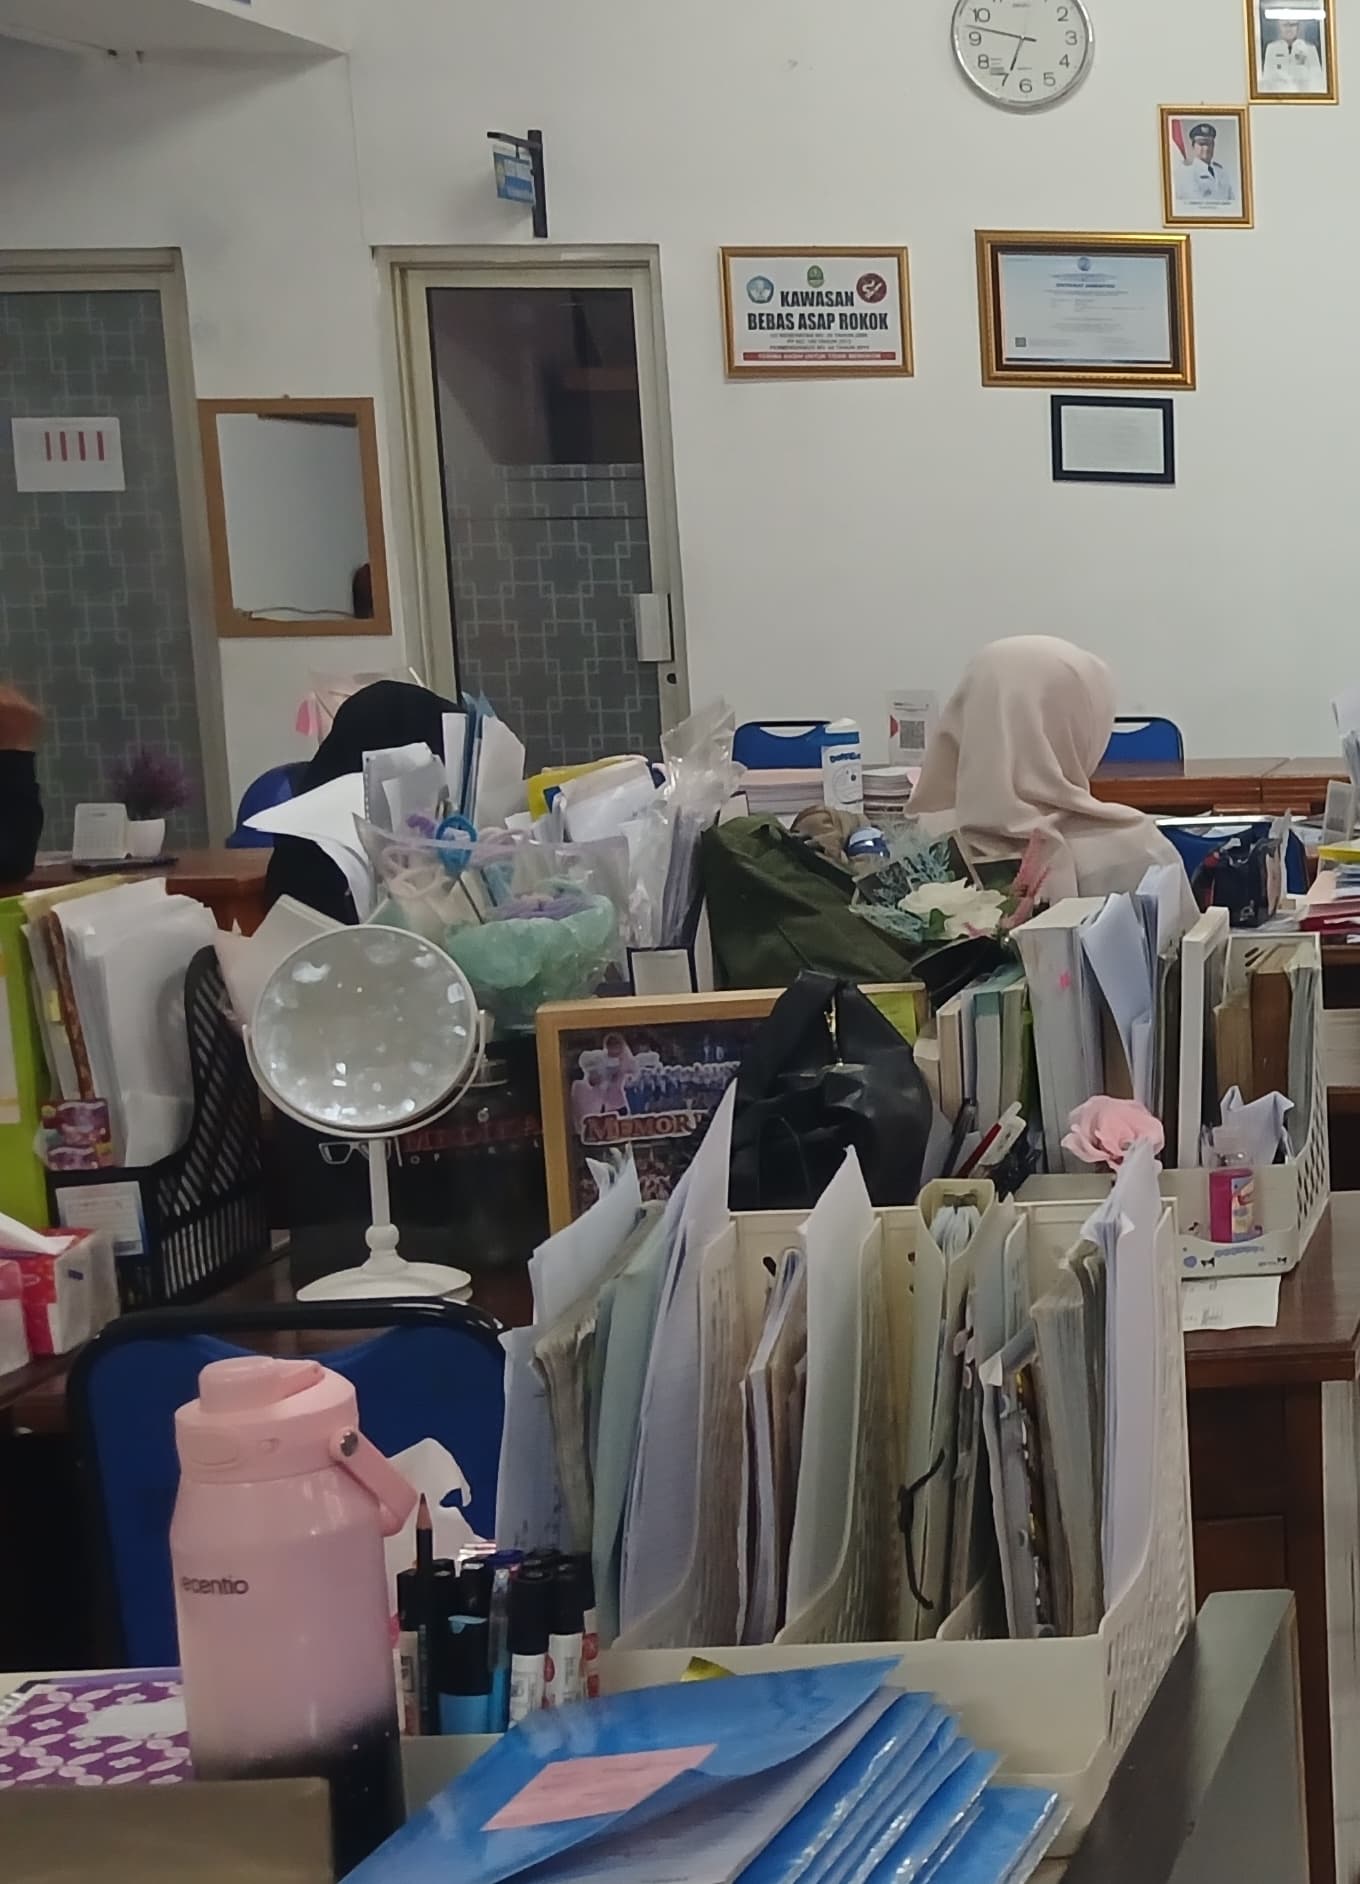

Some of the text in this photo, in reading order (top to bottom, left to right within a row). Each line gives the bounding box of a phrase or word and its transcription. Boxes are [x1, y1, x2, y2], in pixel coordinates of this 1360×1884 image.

[973, 8, 991, 23] 10
[1056, 6, 1069, 22] 2
[968, 31, 982, 46] 9
[1065, 30, 1078, 46] 3
[977, 54, 990, 69] 8
[1059, 53, 1071, 69] 4
[1019, 78, 1033, 93] 6
[1043, 72, 1056, 87] 5
[780, 290, 855, 307] KAWASAN
[747, 312, 889, 331] BEBAS ASAP ROKOK
